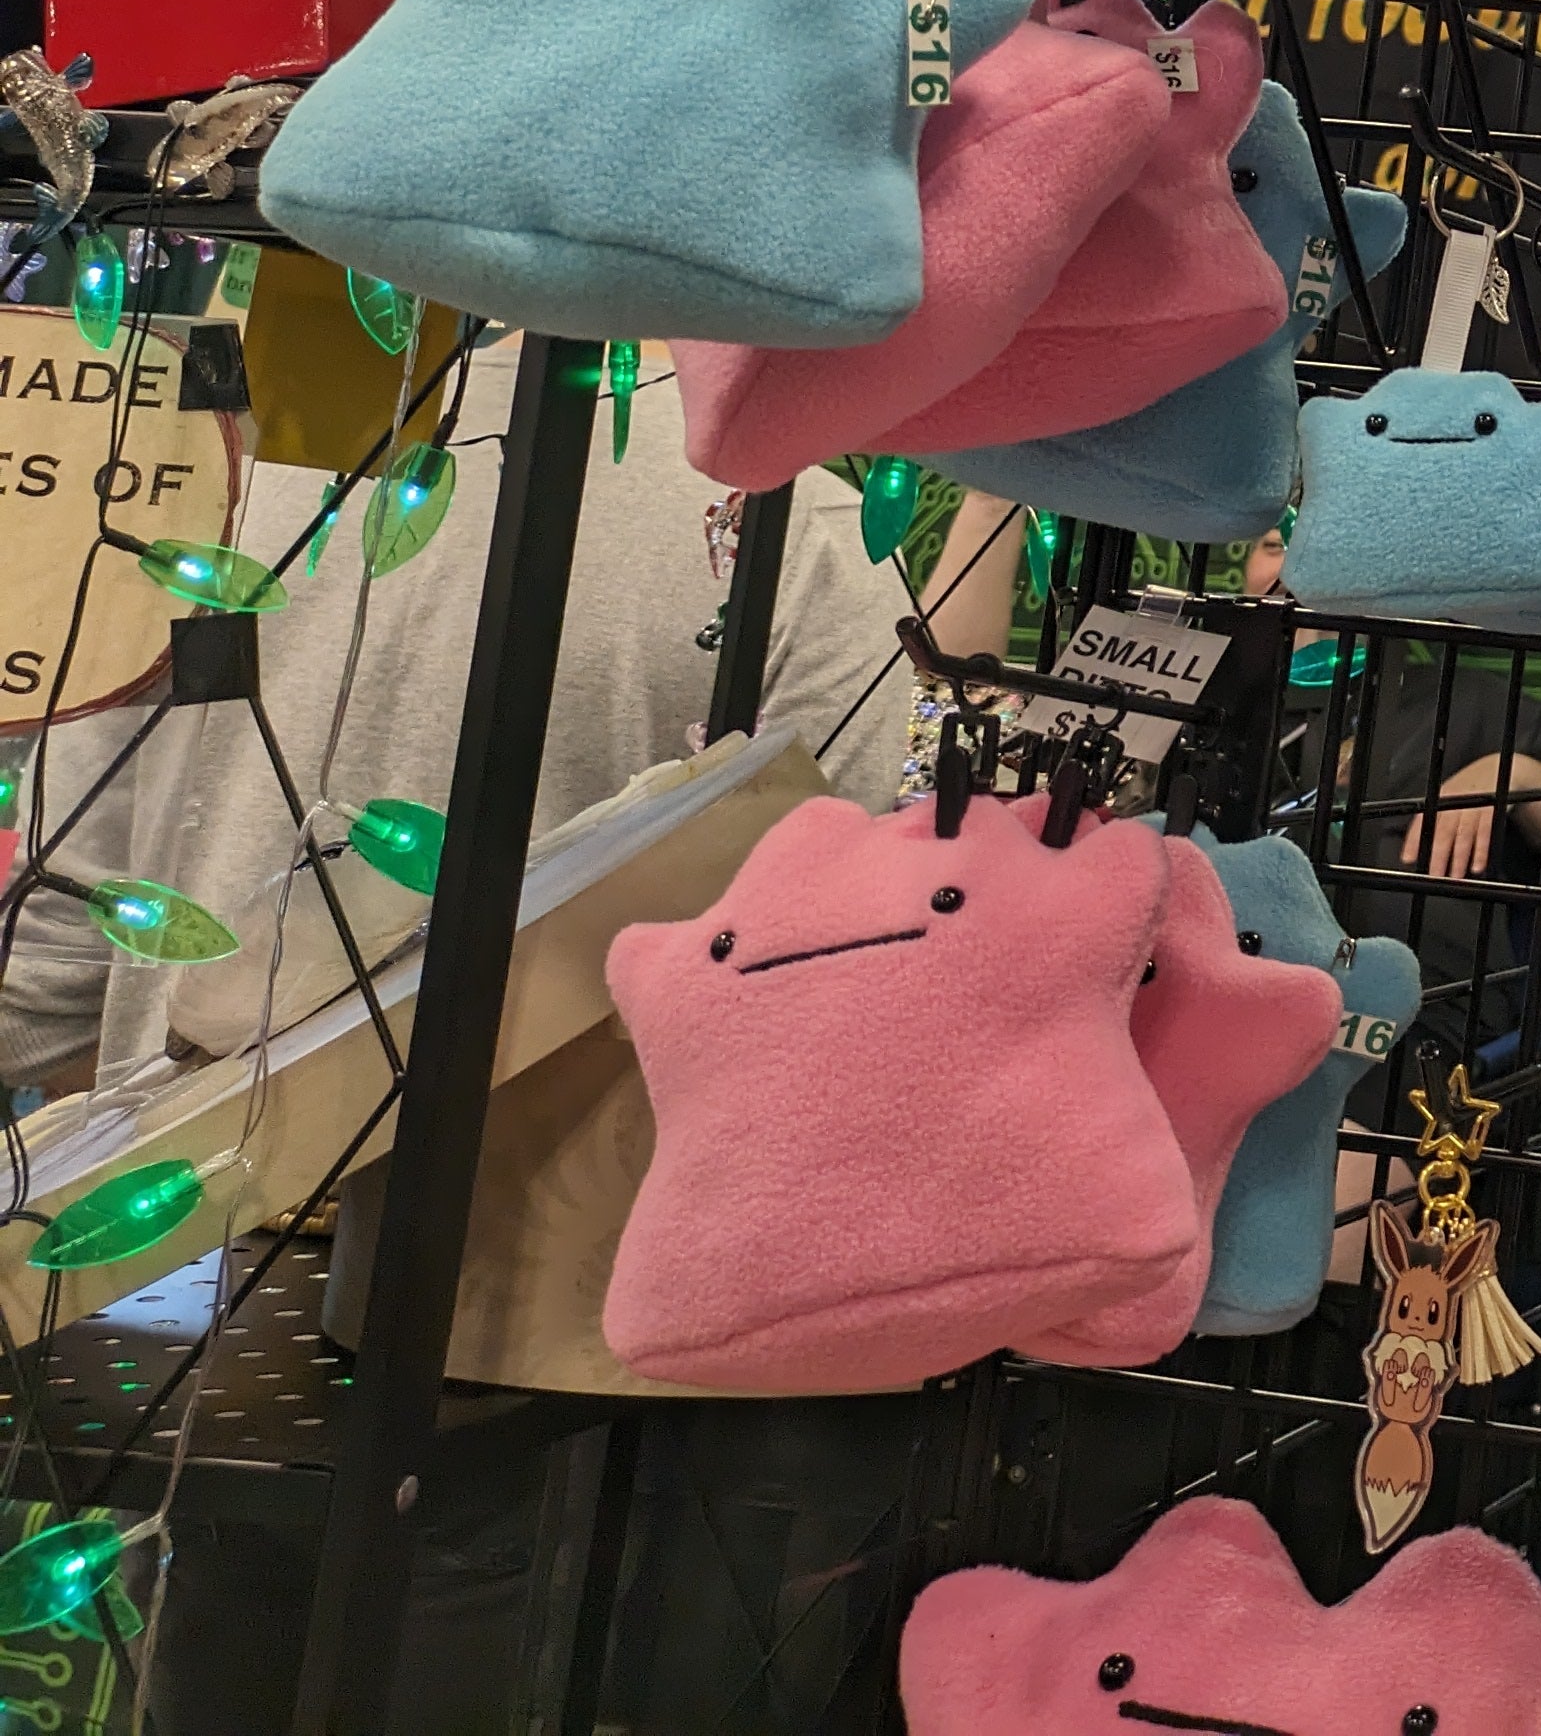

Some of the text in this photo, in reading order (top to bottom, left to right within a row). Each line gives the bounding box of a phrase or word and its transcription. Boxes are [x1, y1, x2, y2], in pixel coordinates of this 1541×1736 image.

[910, 3, 949, 103] $16
[1295, 235, 1338, 316] $16
[93, 458, 195, 505] OF
[1073, 630, 1204, 683] SMALL
[1340, 1015, 1393, 1055] 16
